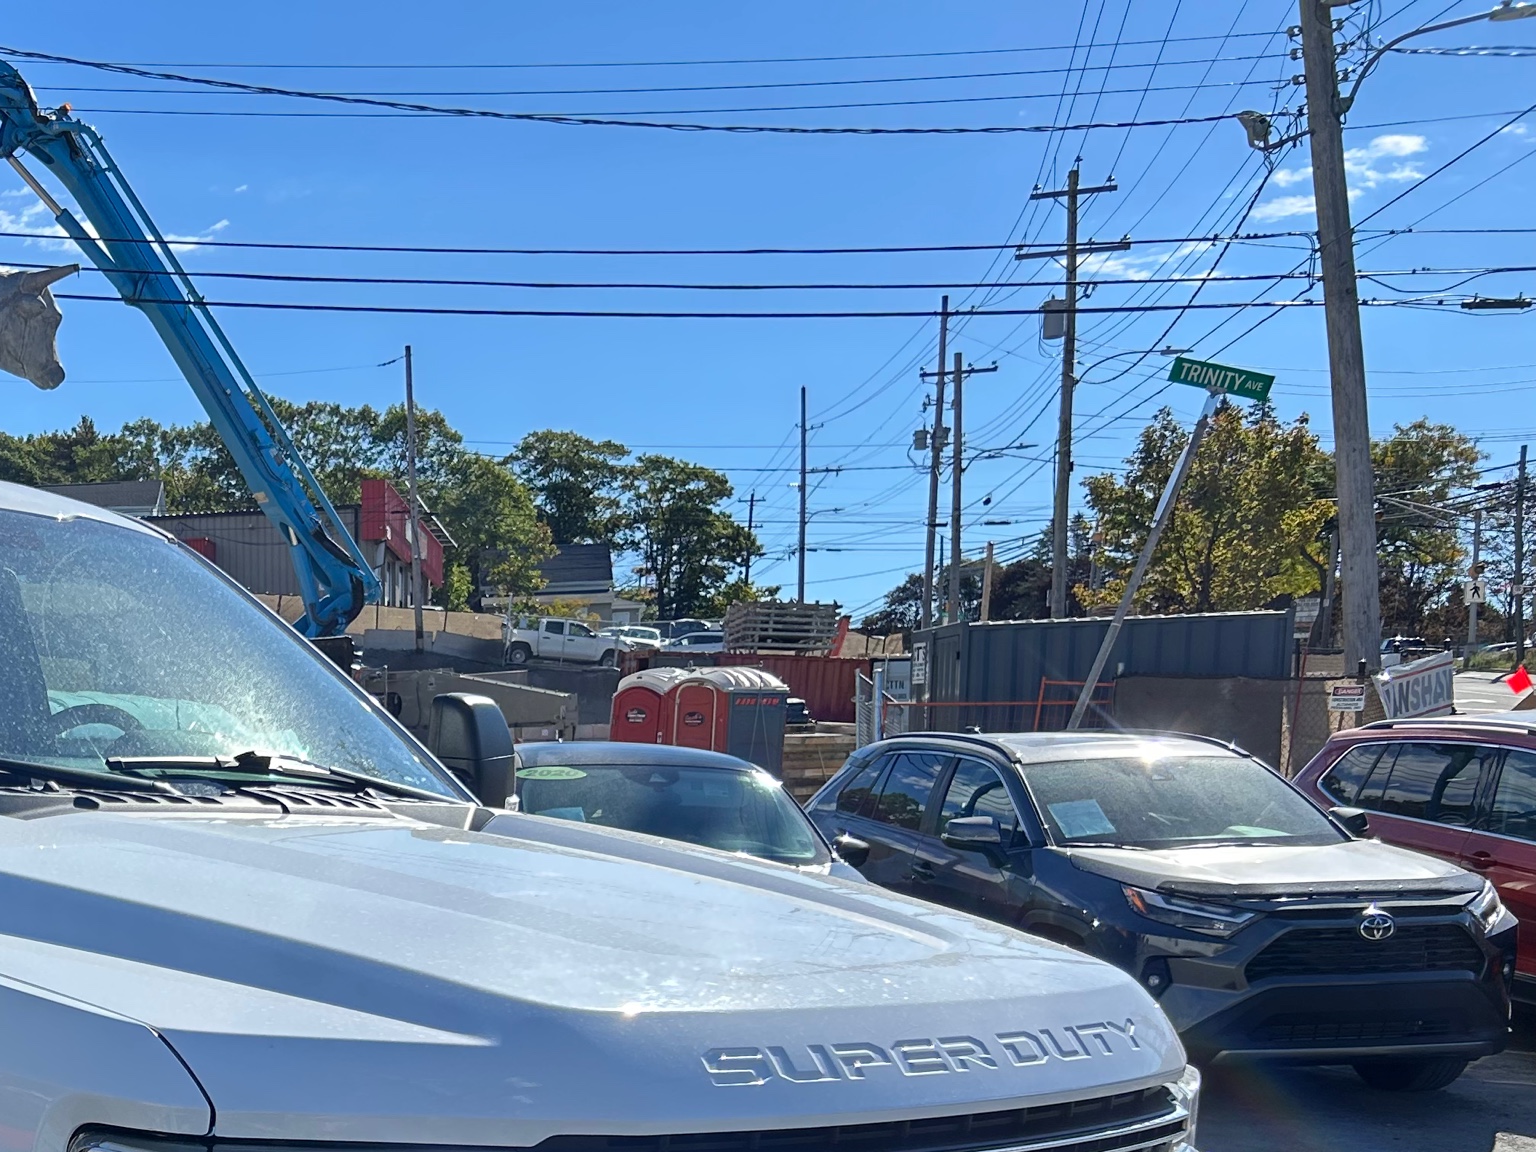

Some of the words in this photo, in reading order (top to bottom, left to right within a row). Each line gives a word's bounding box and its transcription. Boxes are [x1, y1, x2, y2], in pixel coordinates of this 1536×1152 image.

[1179, 362, 1246, 391] TRINITY
[1244, 380, 1264, 392] AVE
[524, 769, 579, 777] 2020
[700, 1035, 998, 1087] SUPER
[994, 1018, 1140, 1067] DUTY
